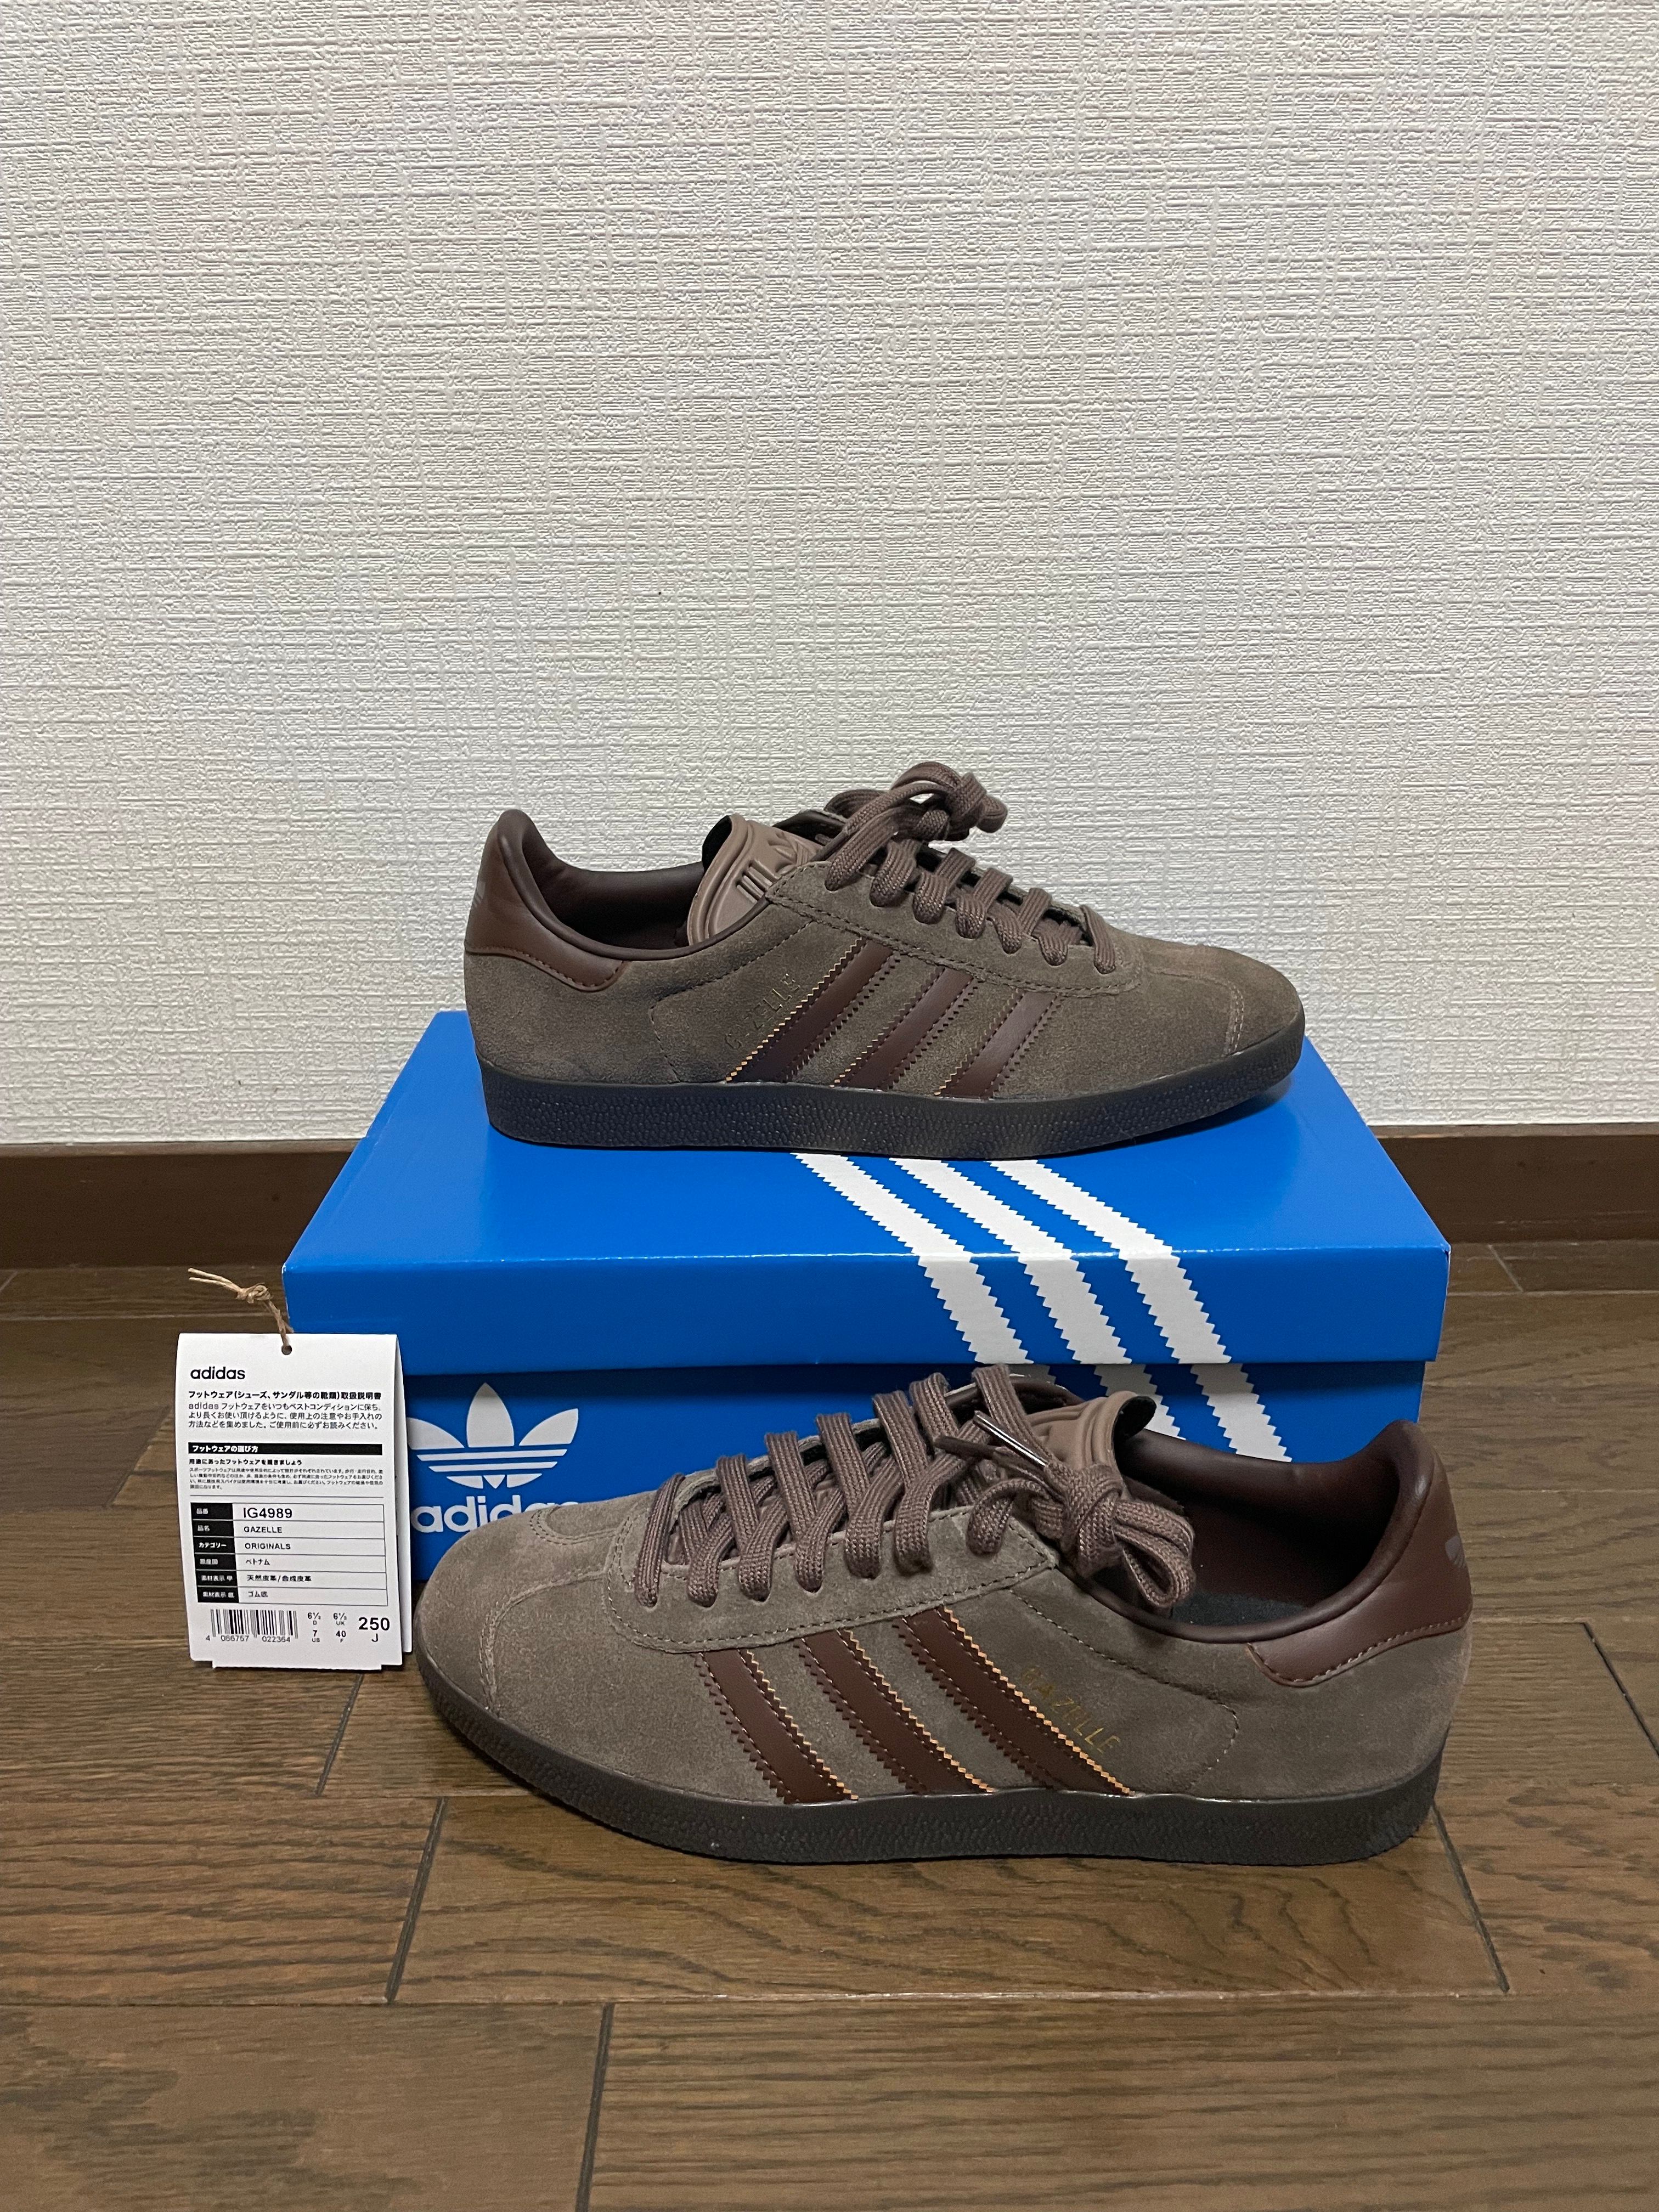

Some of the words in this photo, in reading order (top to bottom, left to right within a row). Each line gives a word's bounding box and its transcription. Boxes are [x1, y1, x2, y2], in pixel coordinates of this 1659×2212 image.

[725, 973, 800, 1049] GZELLE
[190, 1366, 245, 1380] adidas
[192, 1445, 258, 1453] フットウェアの選び方
[243, 1507, 293, 1519] IG4989
[411, 1494, 579, 1533] adid
[247, 1575, 312, 1583] 天然皮革/合成皮革
[358, 1617, 390, 1631] 250
[371, 1633, 379, 1642] J
